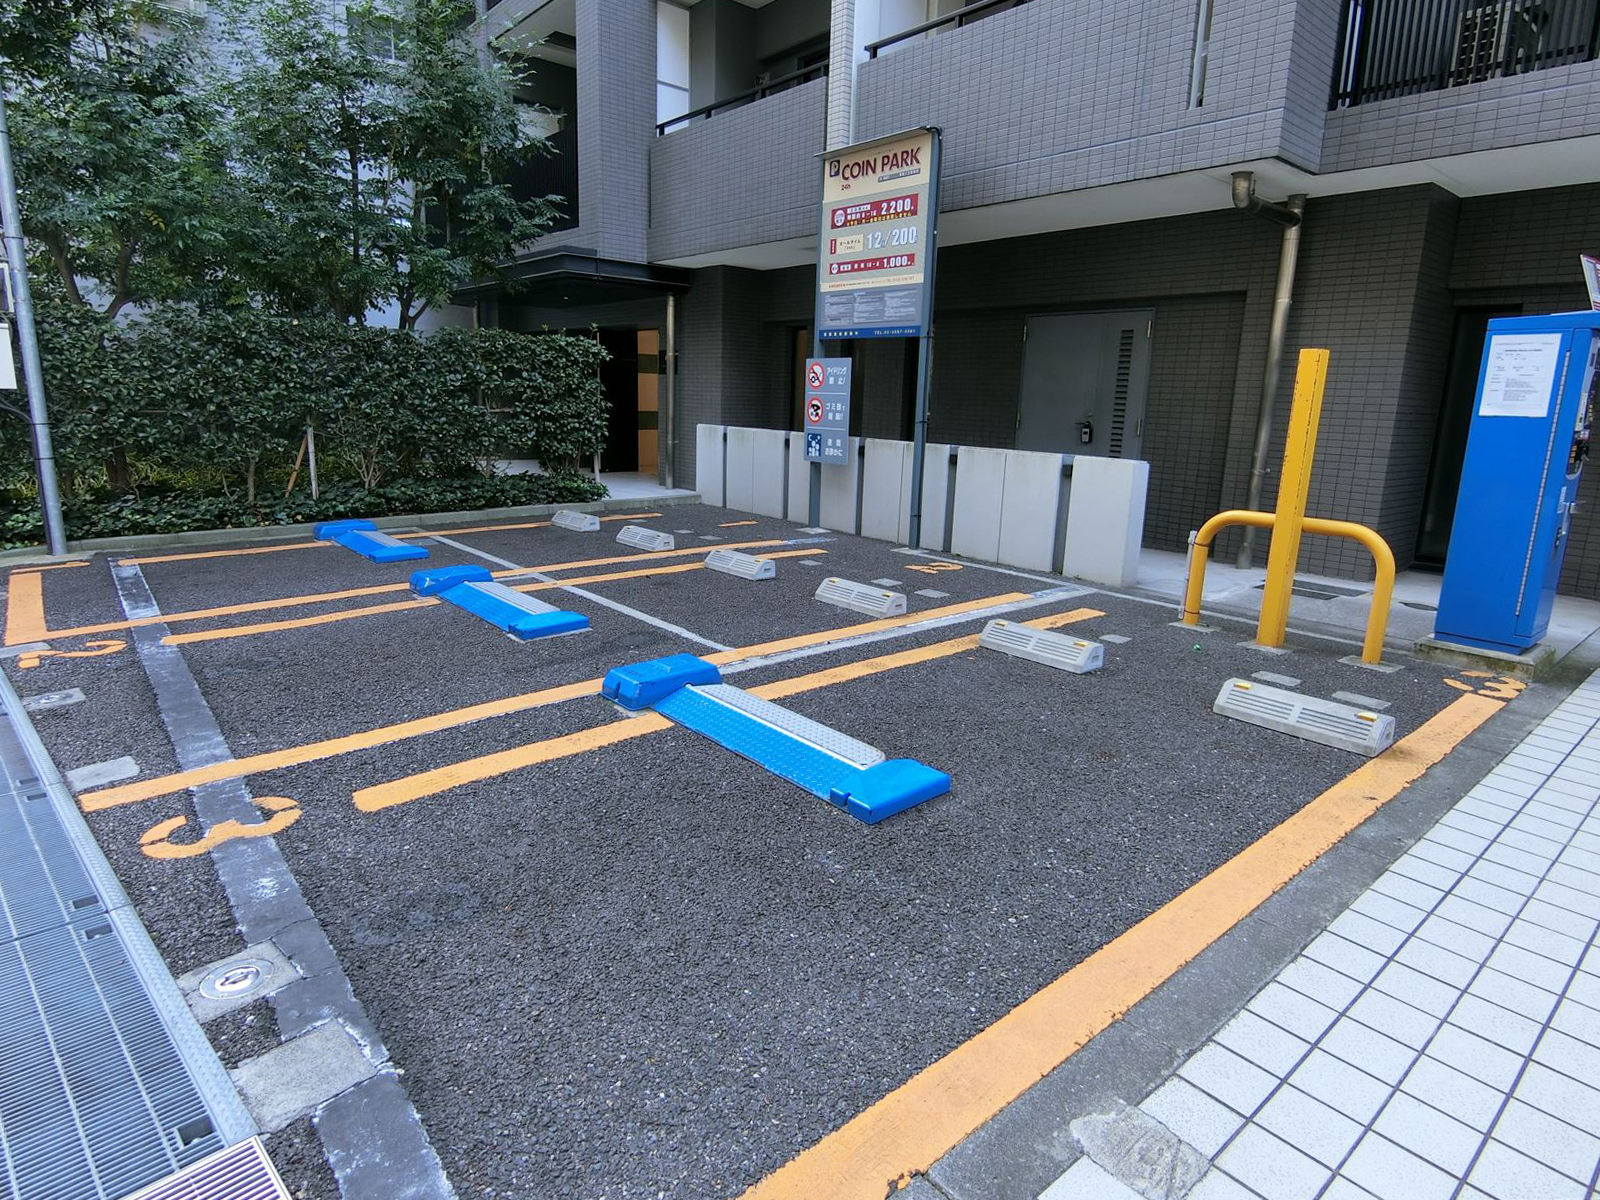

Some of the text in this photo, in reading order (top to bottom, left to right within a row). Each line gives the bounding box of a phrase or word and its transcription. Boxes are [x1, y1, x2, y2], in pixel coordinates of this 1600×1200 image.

[841, 157, 877, 181] COIN
[881, 146, 921, 173] PARK
[138, 796, 303, 859] 3
